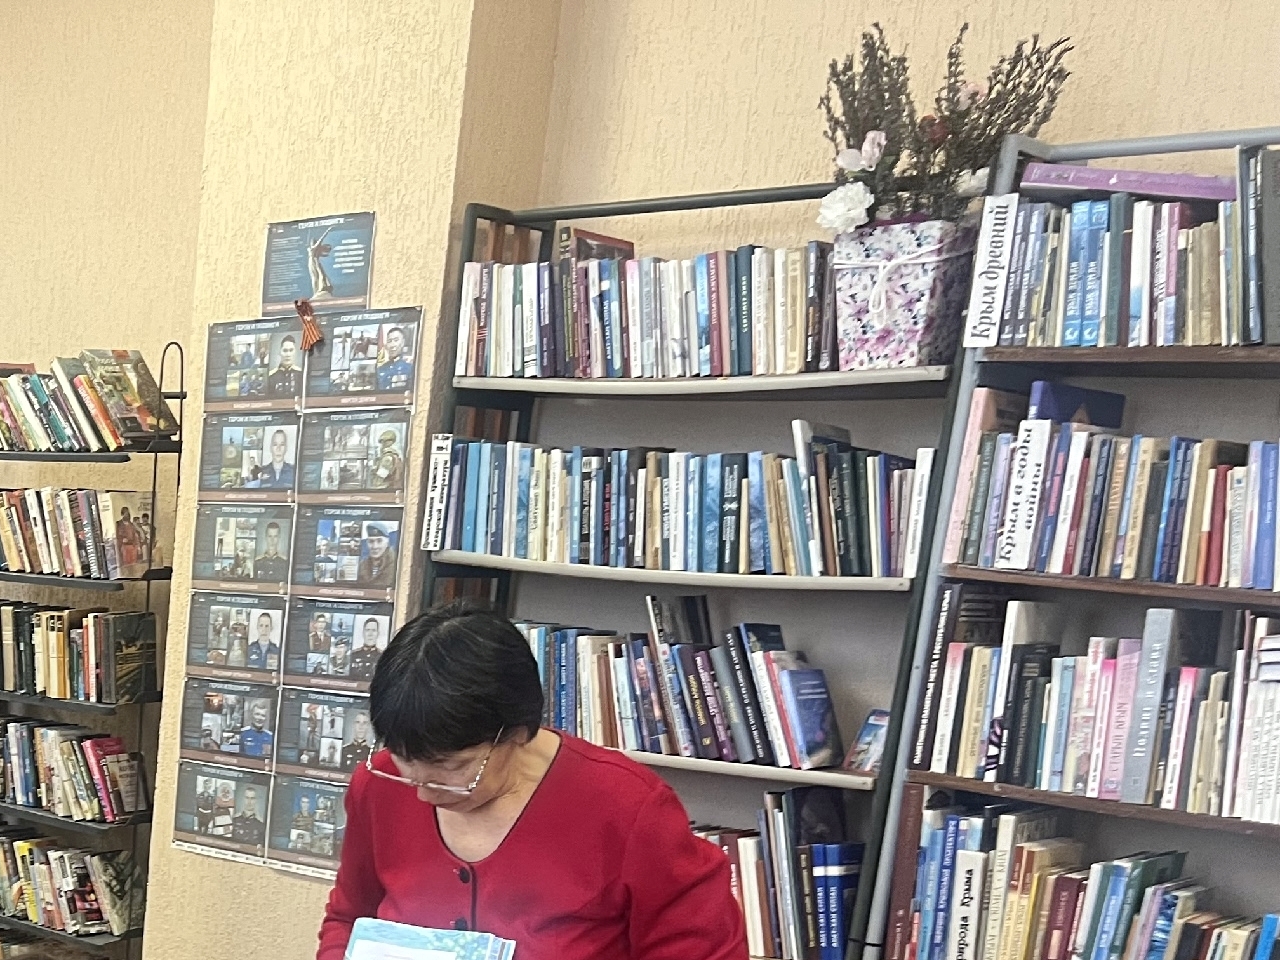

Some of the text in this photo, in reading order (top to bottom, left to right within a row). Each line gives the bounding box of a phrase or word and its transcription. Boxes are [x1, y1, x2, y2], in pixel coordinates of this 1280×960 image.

[970, 204, 1009, 339] Крым древний
[1001, 501, 1020, 562] Крым
[1016, 427, 1033, 480] годы
[1024, 462, 1042, 531] войны
[959, 869, 974, 907] Крыма
